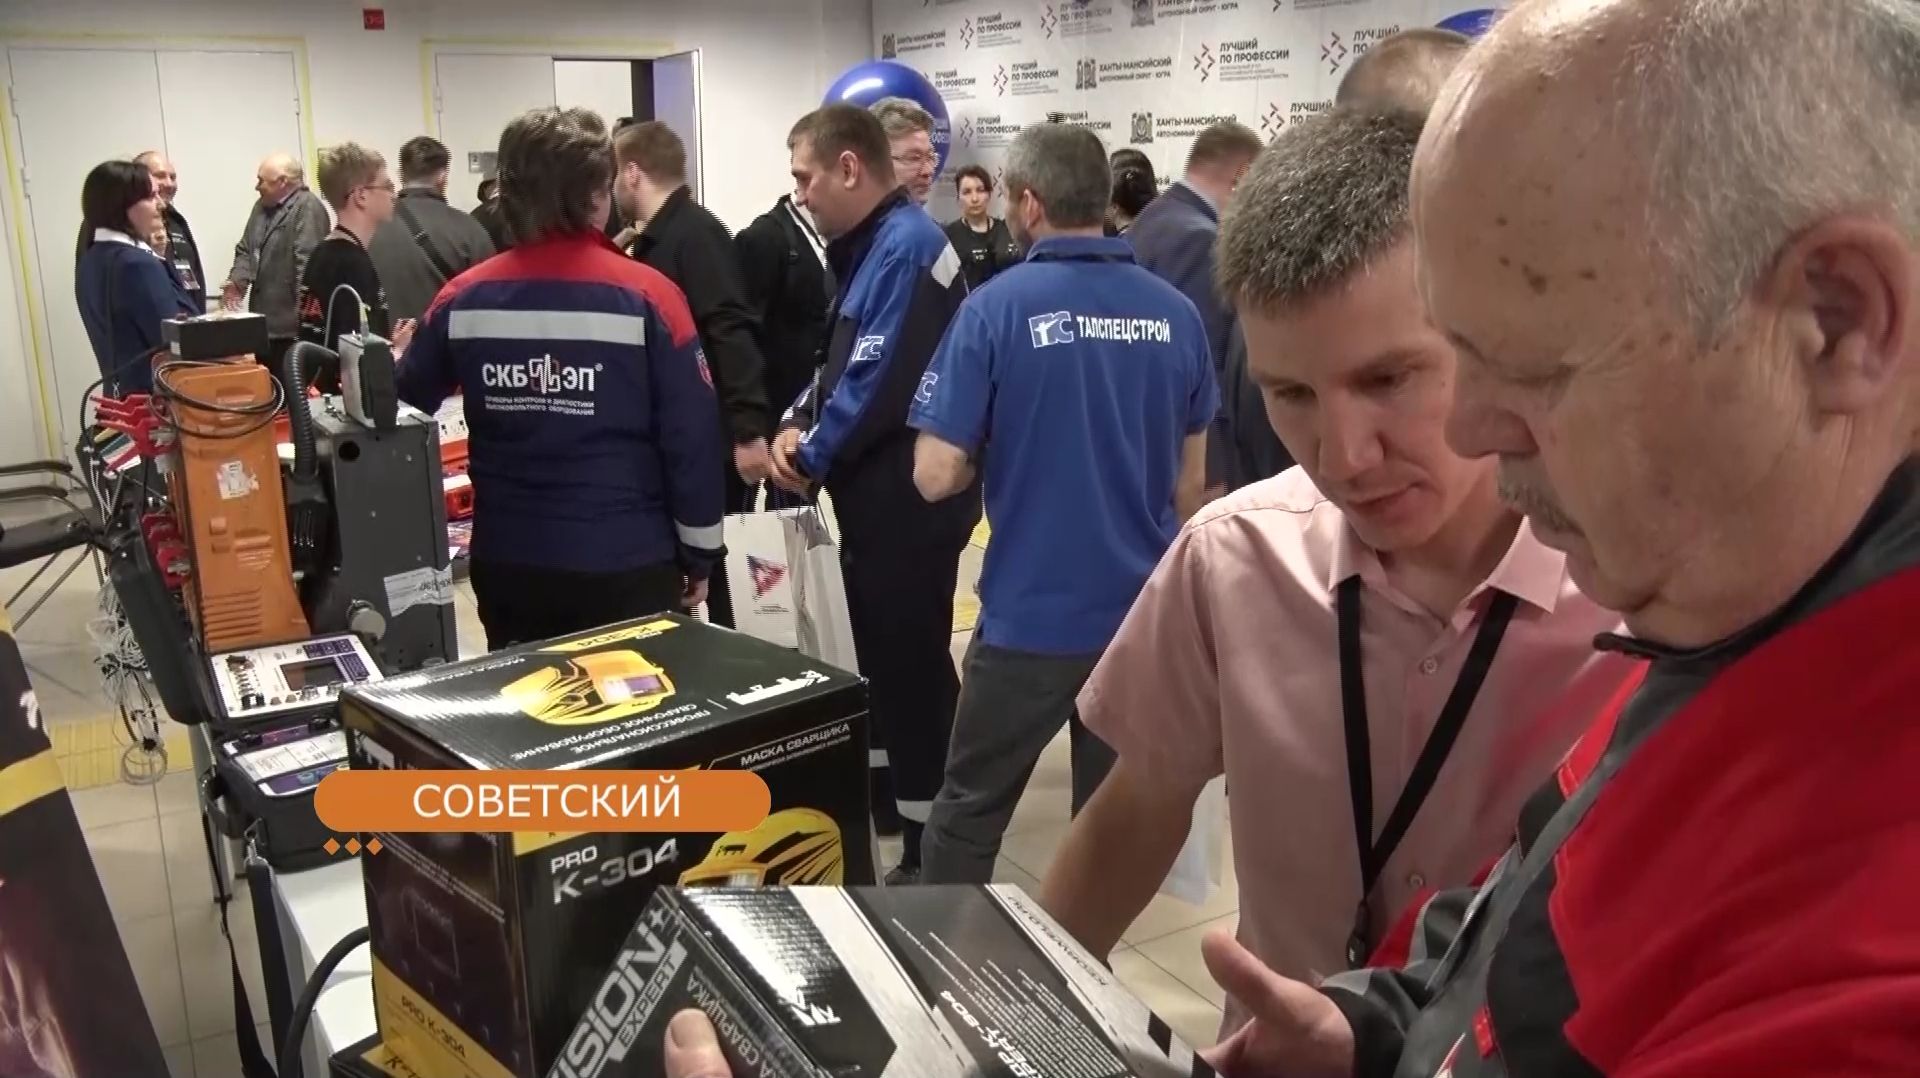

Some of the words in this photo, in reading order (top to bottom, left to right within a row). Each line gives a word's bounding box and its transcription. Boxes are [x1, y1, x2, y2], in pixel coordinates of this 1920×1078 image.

[1220, 38, 1258, 52] ЛУЧШИЙ
[1220, 54, 1232, 64] ПО
[1234, 49, 1290, 62] ПРОФЕССИИ
[482, 363, 529, 387] СКБ
[570, 708, 711, 754] ПРОФЕССИОНАЛЬНОЕ
[620, 702, 697, 729] СВАРОЧНОЕ
[511, 724, 622, 761] ОБОРУДОВАНИЕ
[740, 743, 784, 767] МАСКА
[785, 722, 850, 752] СВАРЩИКА
[551, 845, 598, 874] PRO
[552, 837, 680, 905] K-304
[618, 952, 679, 1047] EXPERT
[686, 965, 760, 1065] СВАРЩИКА
